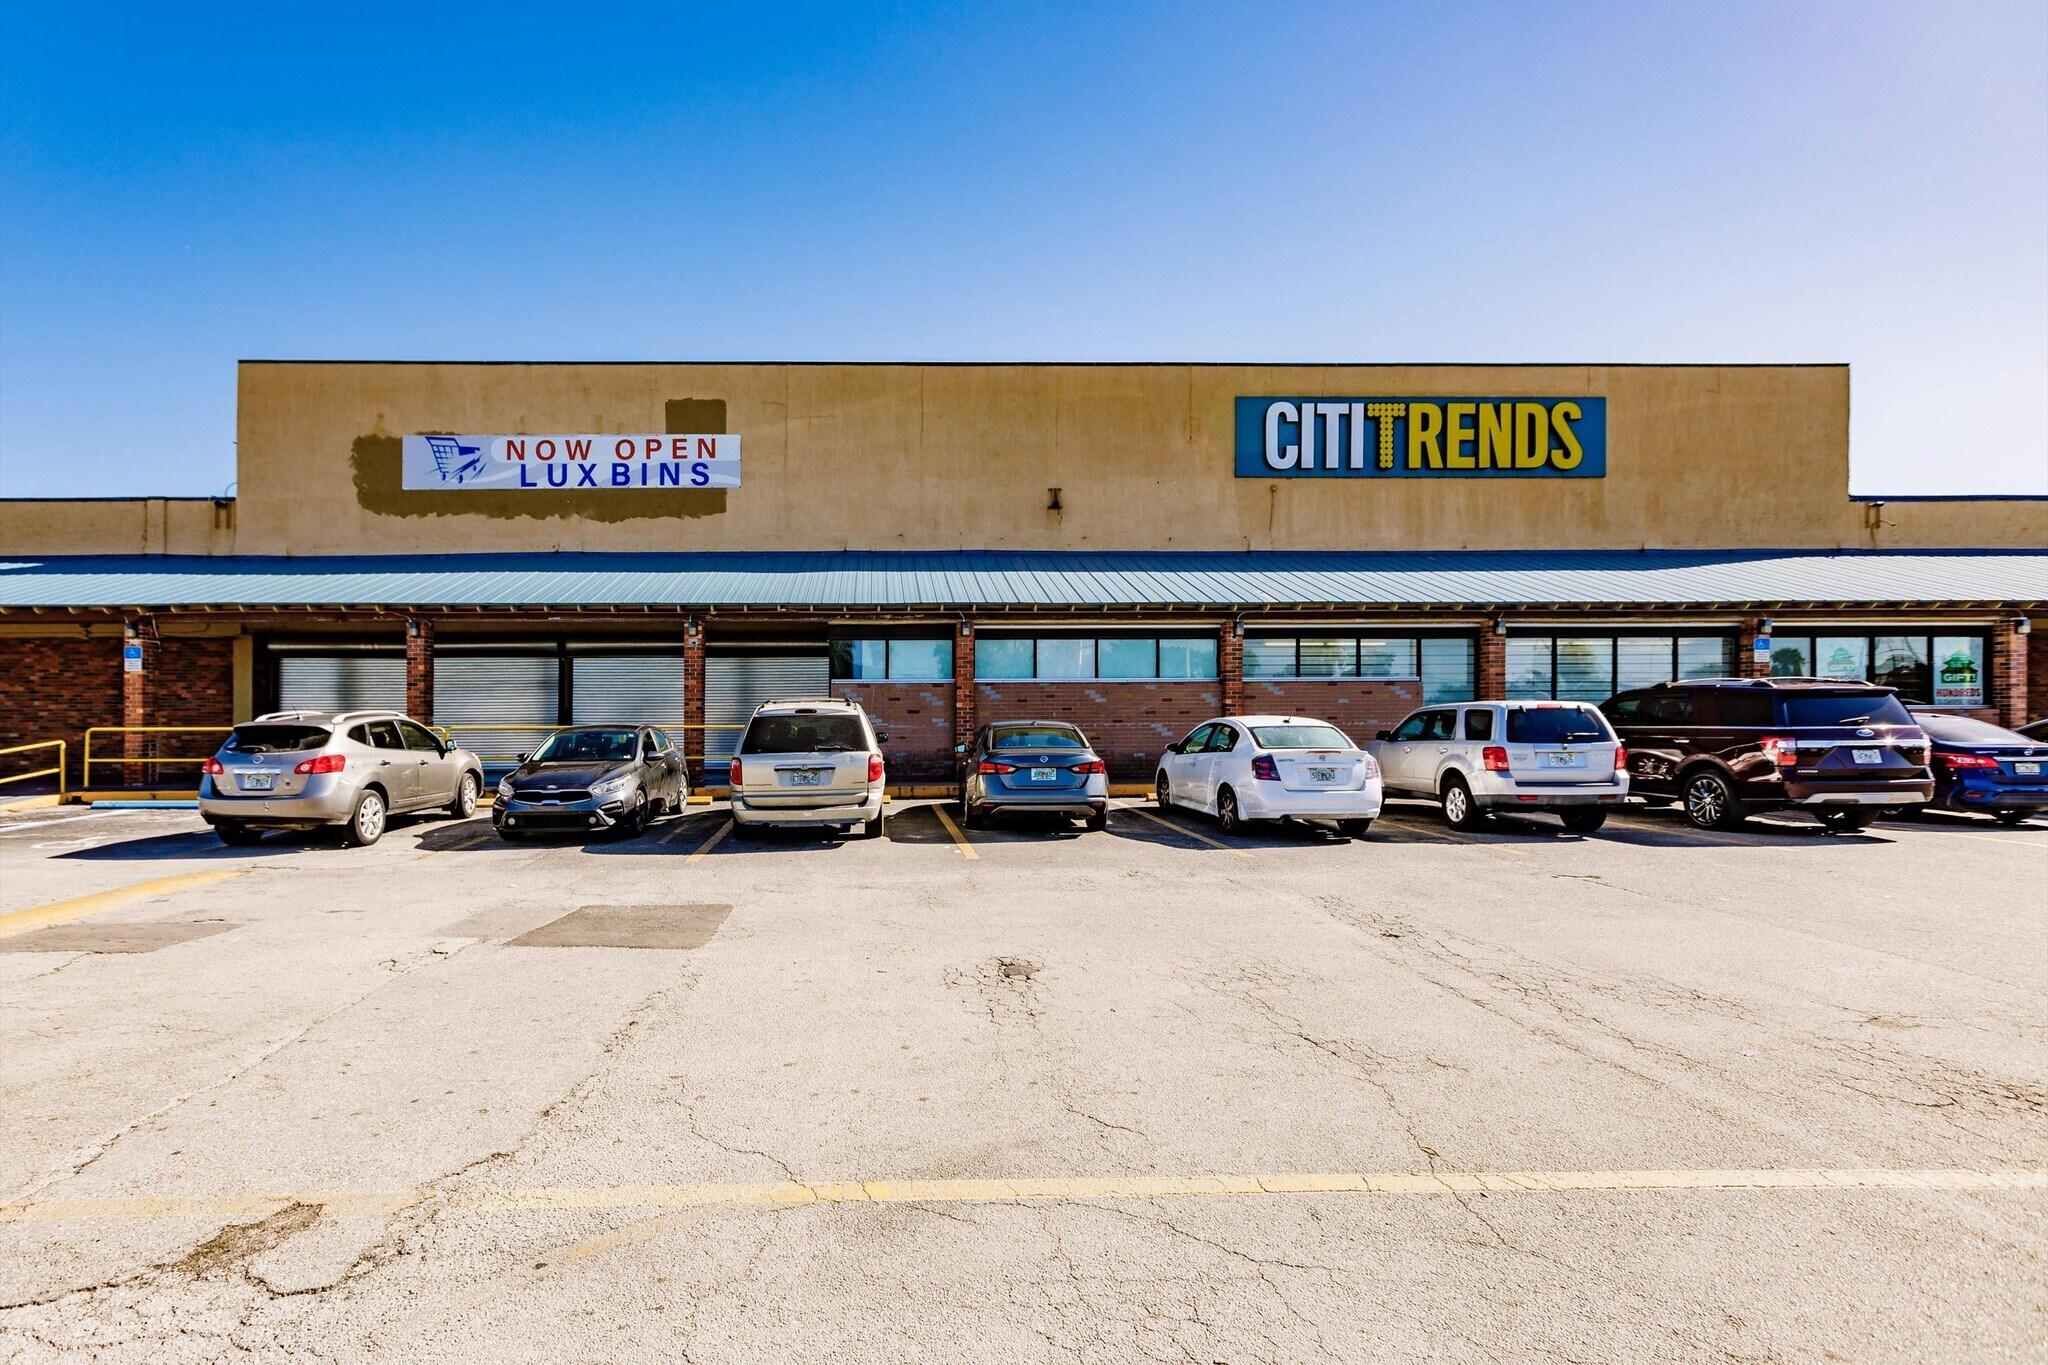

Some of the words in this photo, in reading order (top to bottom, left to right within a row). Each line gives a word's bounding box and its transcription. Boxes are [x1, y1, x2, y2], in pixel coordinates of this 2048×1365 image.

[506, 439, 592, 461] NOW
[614, 438, 716, 461] OPEN
[1943, 673, 1976, 682] GIFT!
